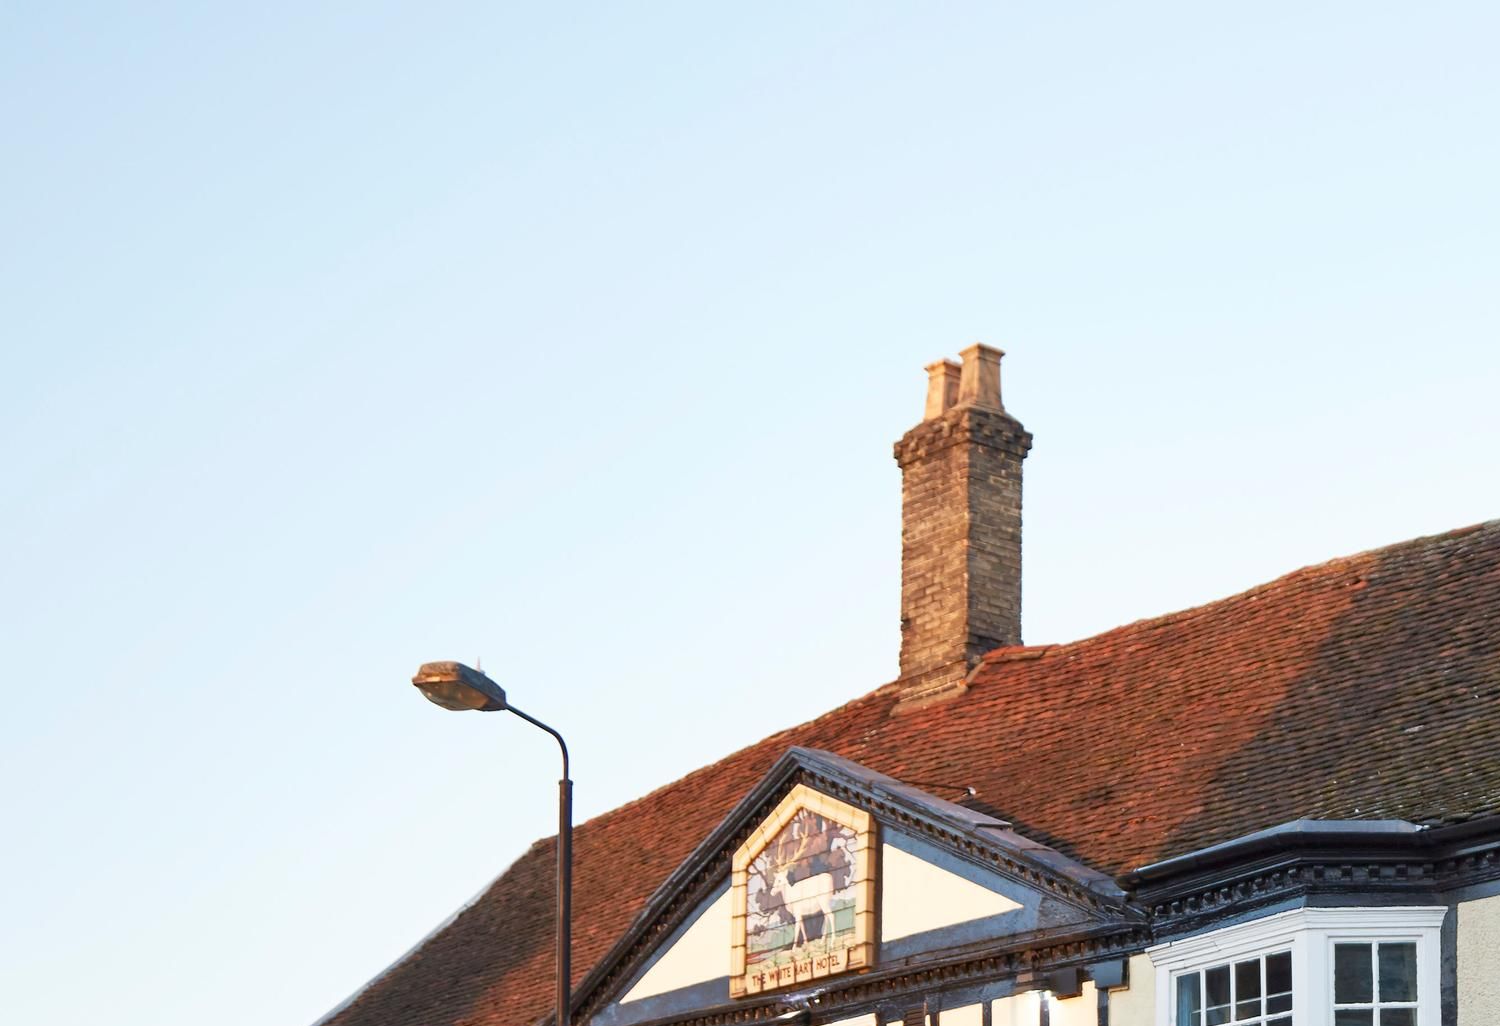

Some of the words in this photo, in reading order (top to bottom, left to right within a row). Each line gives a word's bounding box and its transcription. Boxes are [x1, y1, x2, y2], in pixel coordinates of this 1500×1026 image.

[751, 972, 766, 986] THE
[768, 966, 791, 981] WHITE
[816, 955, 840, 970] HOTEL
